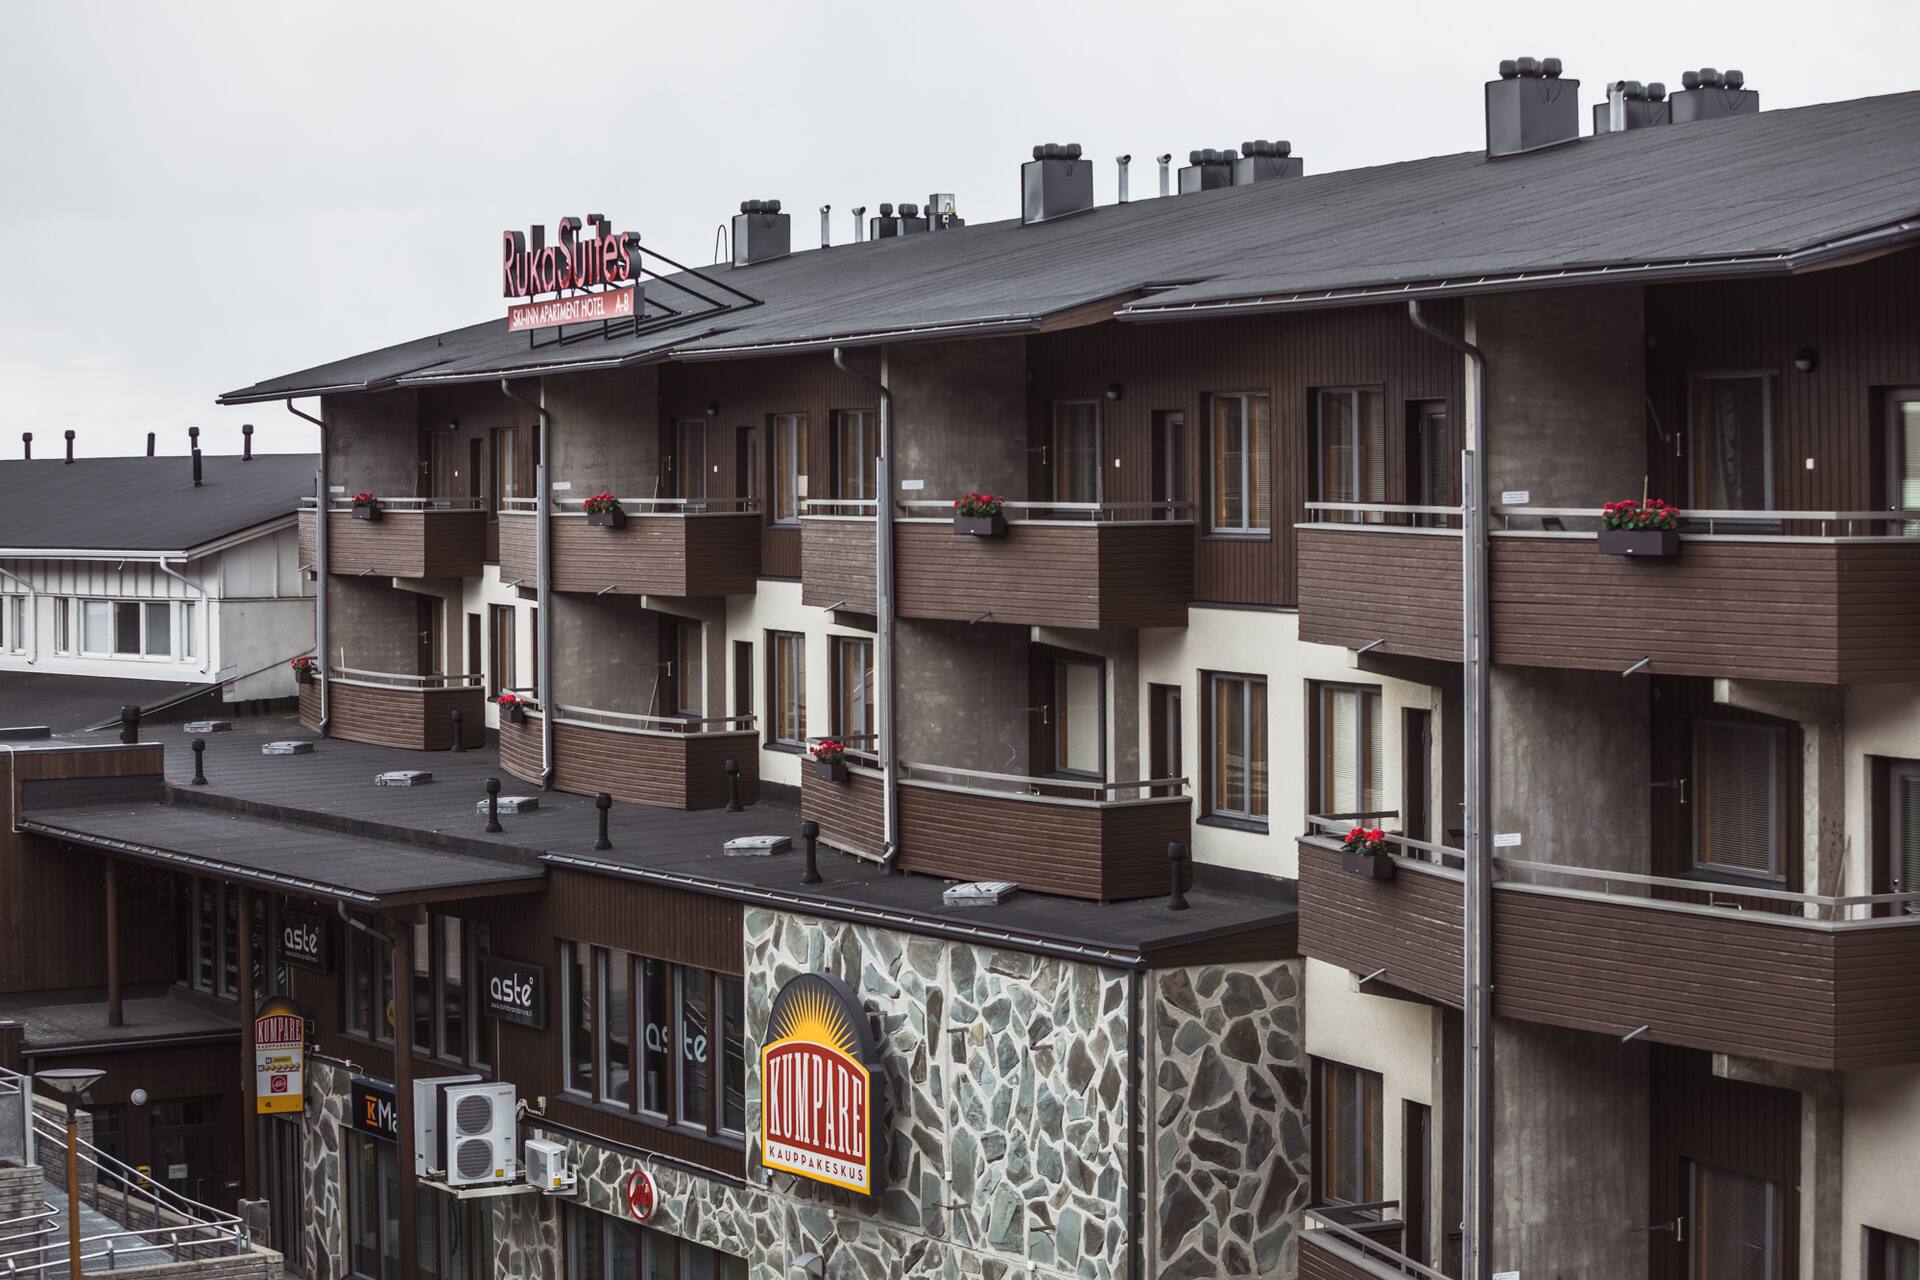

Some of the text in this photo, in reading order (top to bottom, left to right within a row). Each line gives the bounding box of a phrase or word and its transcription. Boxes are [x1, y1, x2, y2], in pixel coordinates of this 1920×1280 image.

[513, 293, 629, 327] SKI-INN APARTMENT HOTEL A-B
[258, 1017, 300, 1042] KUMPARE
[769, 1052, 863, 1157] KUMPARE
[769, 1145, 864, 1182] KAUPPAKESKUS
